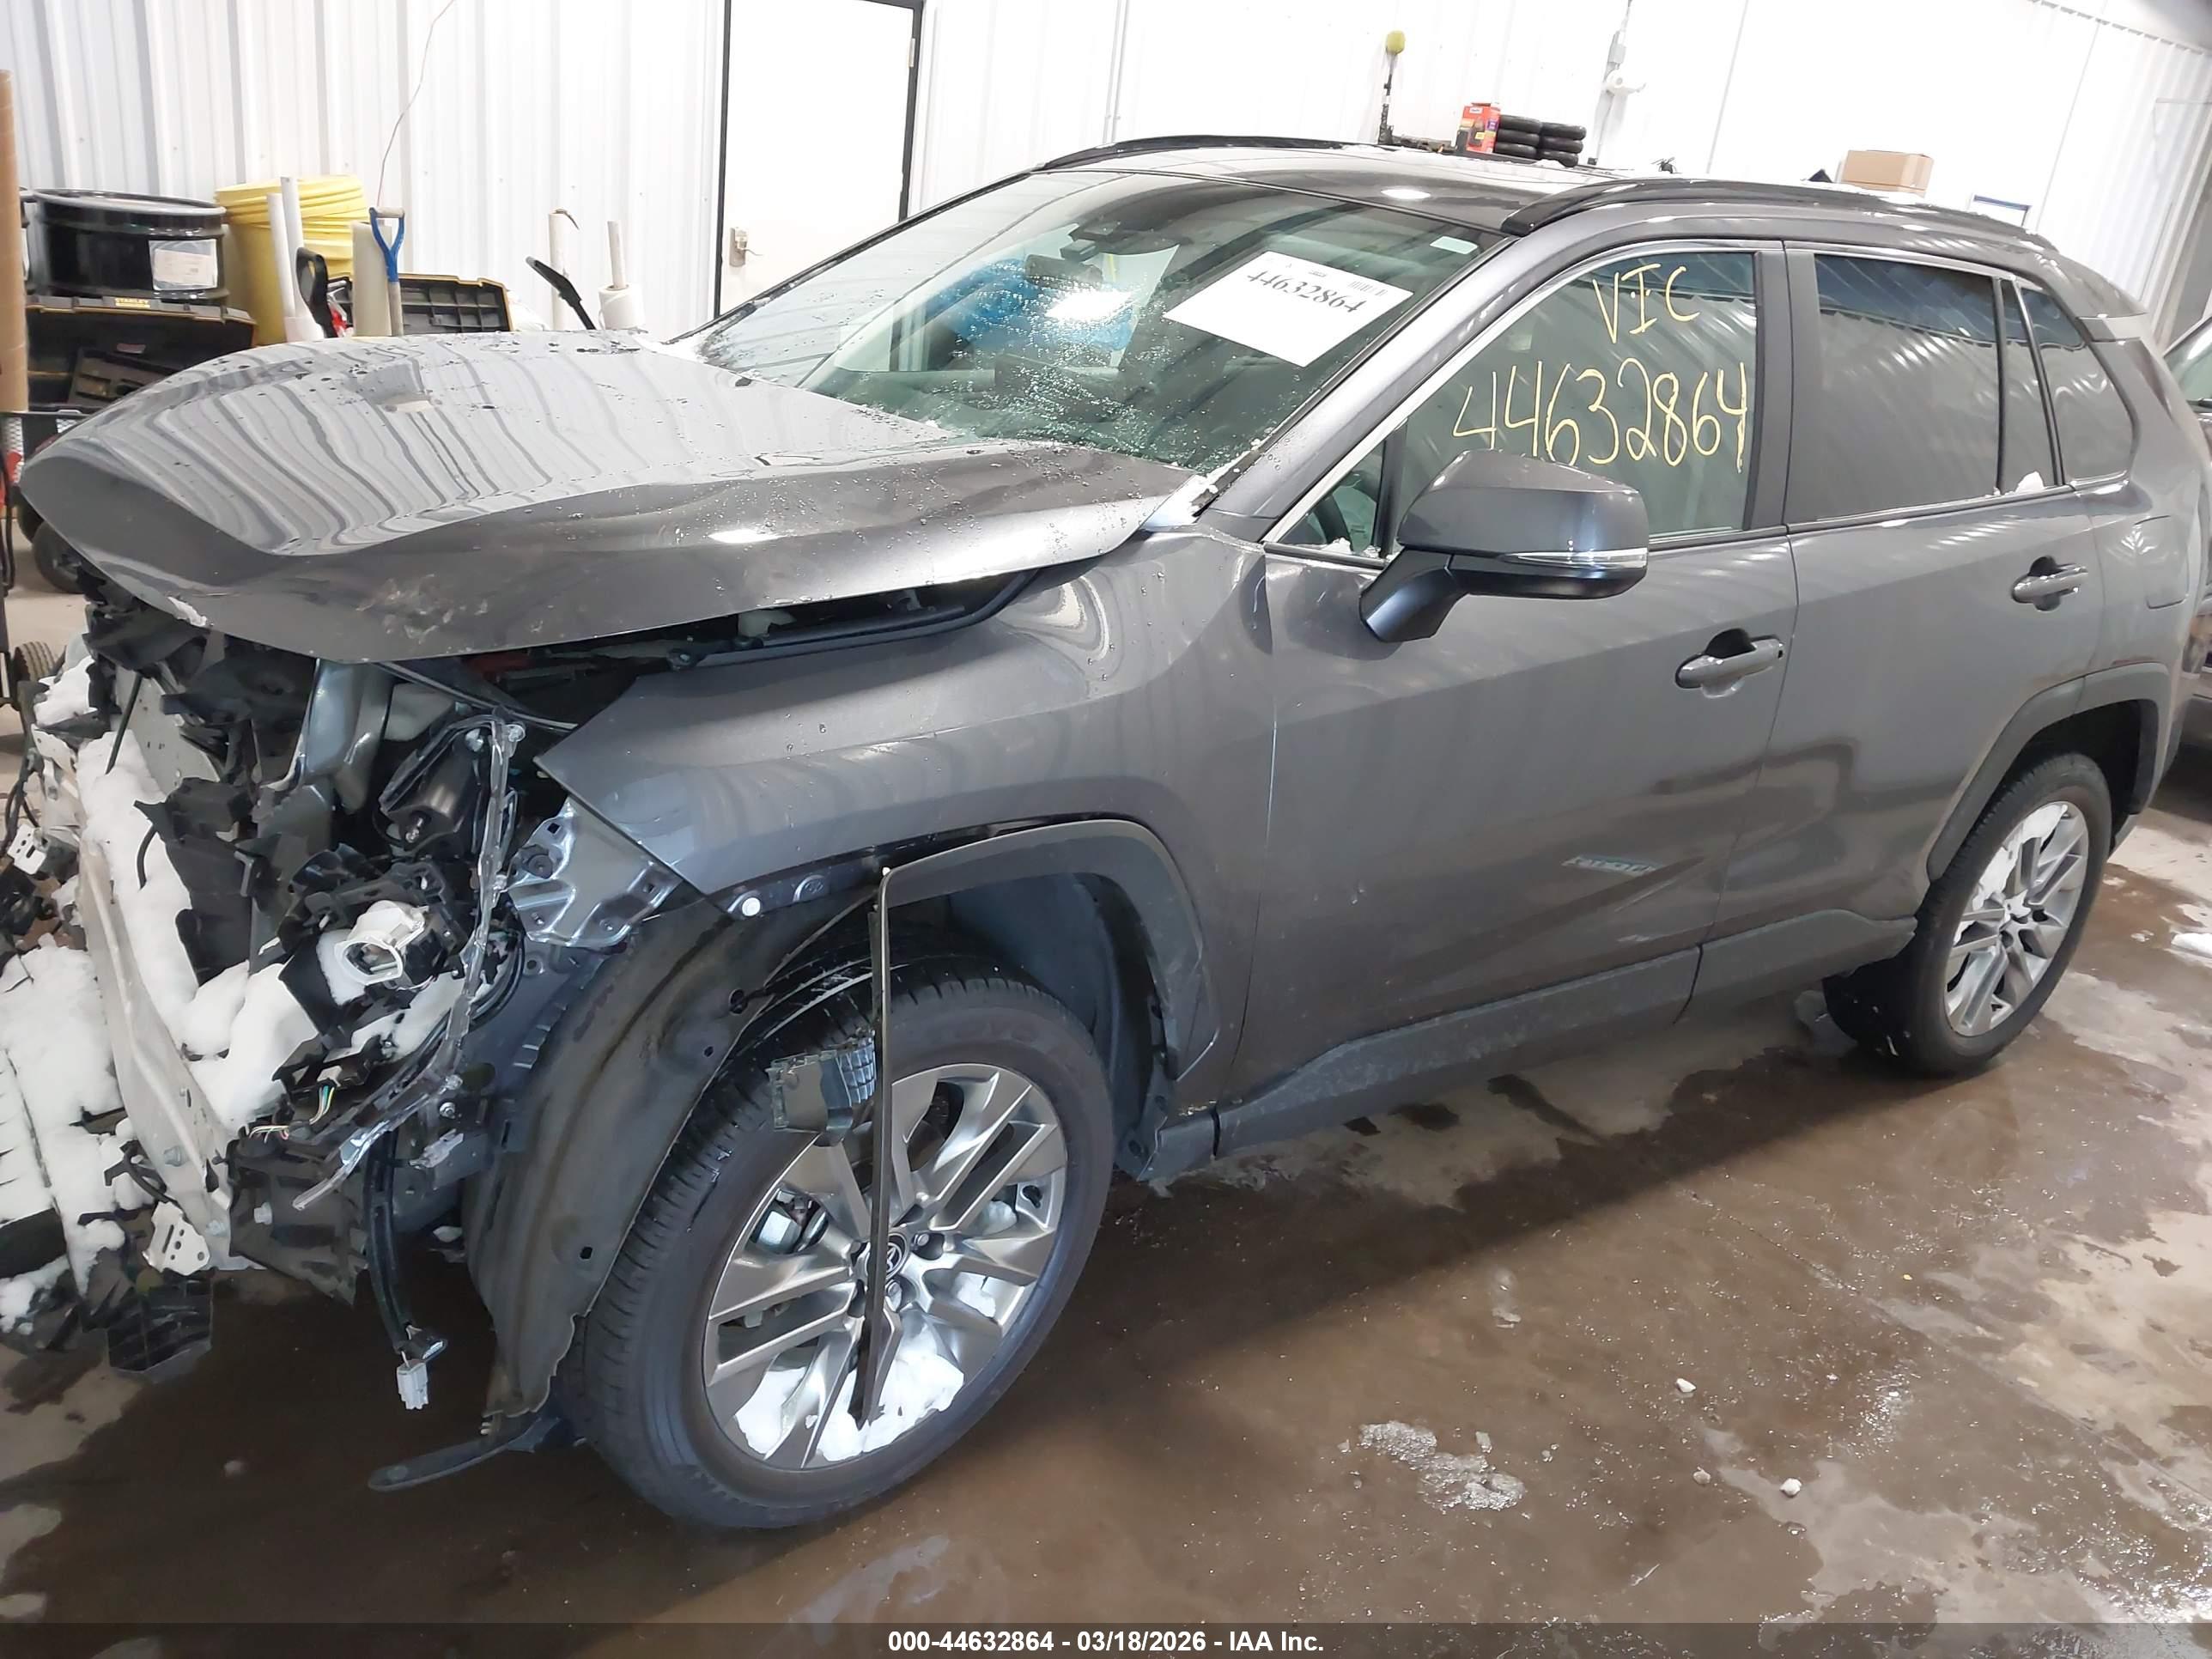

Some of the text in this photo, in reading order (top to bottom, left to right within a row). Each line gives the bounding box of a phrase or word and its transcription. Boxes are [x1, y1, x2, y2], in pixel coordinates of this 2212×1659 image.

[1246, 270, 1368, 313] 44632864
[1591, 263, 1700, 344] VIC
[1452, 357, 1748, 474] 44632864
